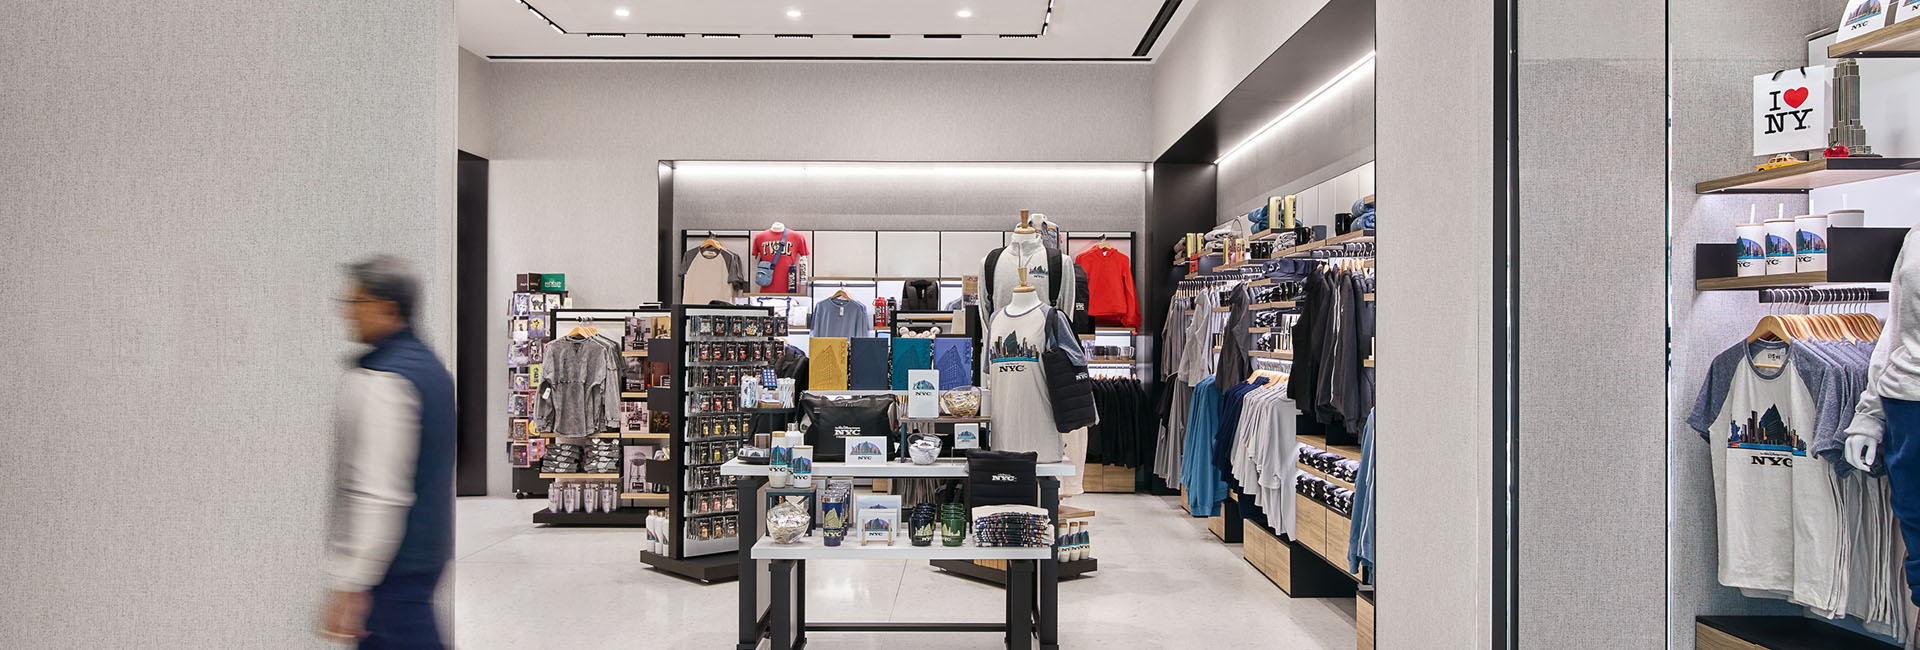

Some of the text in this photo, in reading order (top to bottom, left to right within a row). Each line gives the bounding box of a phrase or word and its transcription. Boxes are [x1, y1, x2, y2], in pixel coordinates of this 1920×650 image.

[1851, 21, 1868, 30] NYC
[1769, 91, 1781, 111] I
[1765, 109, 1813, 134] NY
